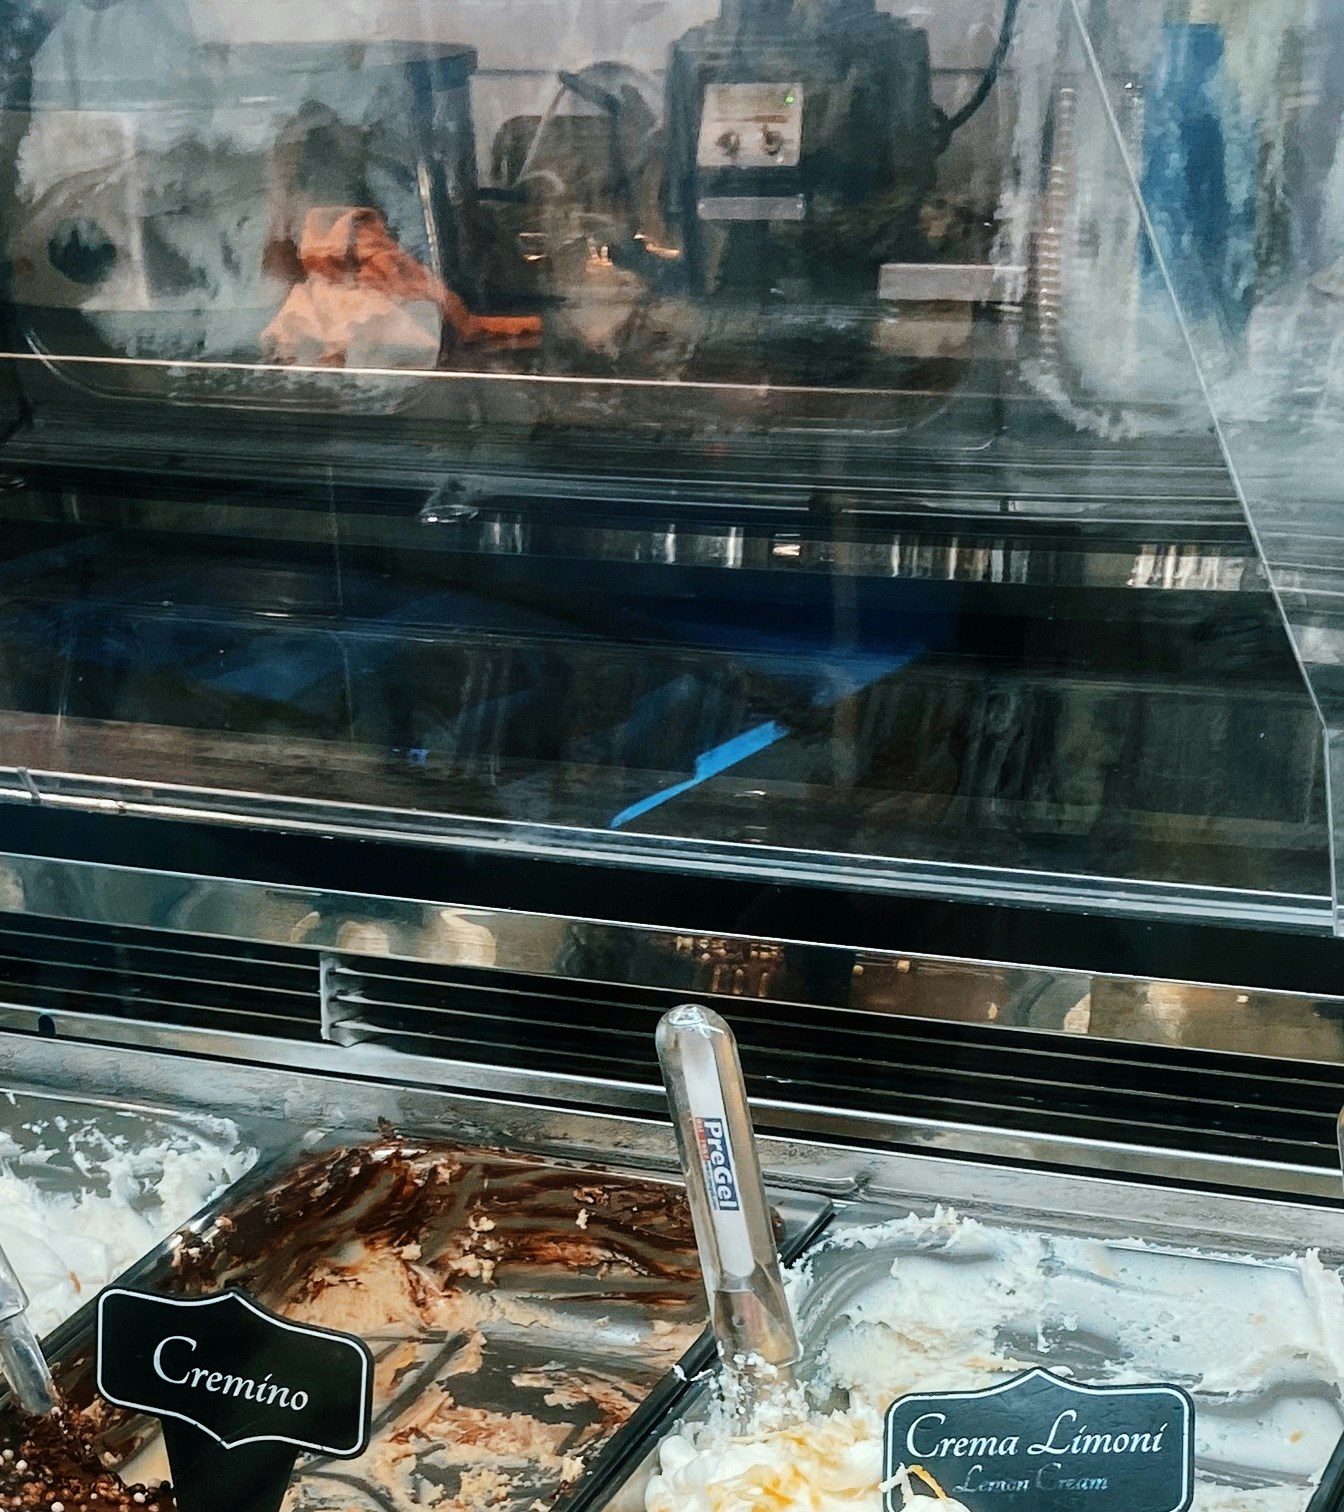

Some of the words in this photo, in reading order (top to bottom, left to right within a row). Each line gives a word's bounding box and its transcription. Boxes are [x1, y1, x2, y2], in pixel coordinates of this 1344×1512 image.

[703, 1122, 737, 1207] PreGel
[153, 1335, 309, 1411] Cremino
[906, 1412, 1020, 1458] Crema
[1027, 1409, 1169, 1454] Limoni
[953, 1464, 1029, 1492] Lemon
[1036, 1462, 1108, 1491] Cream
